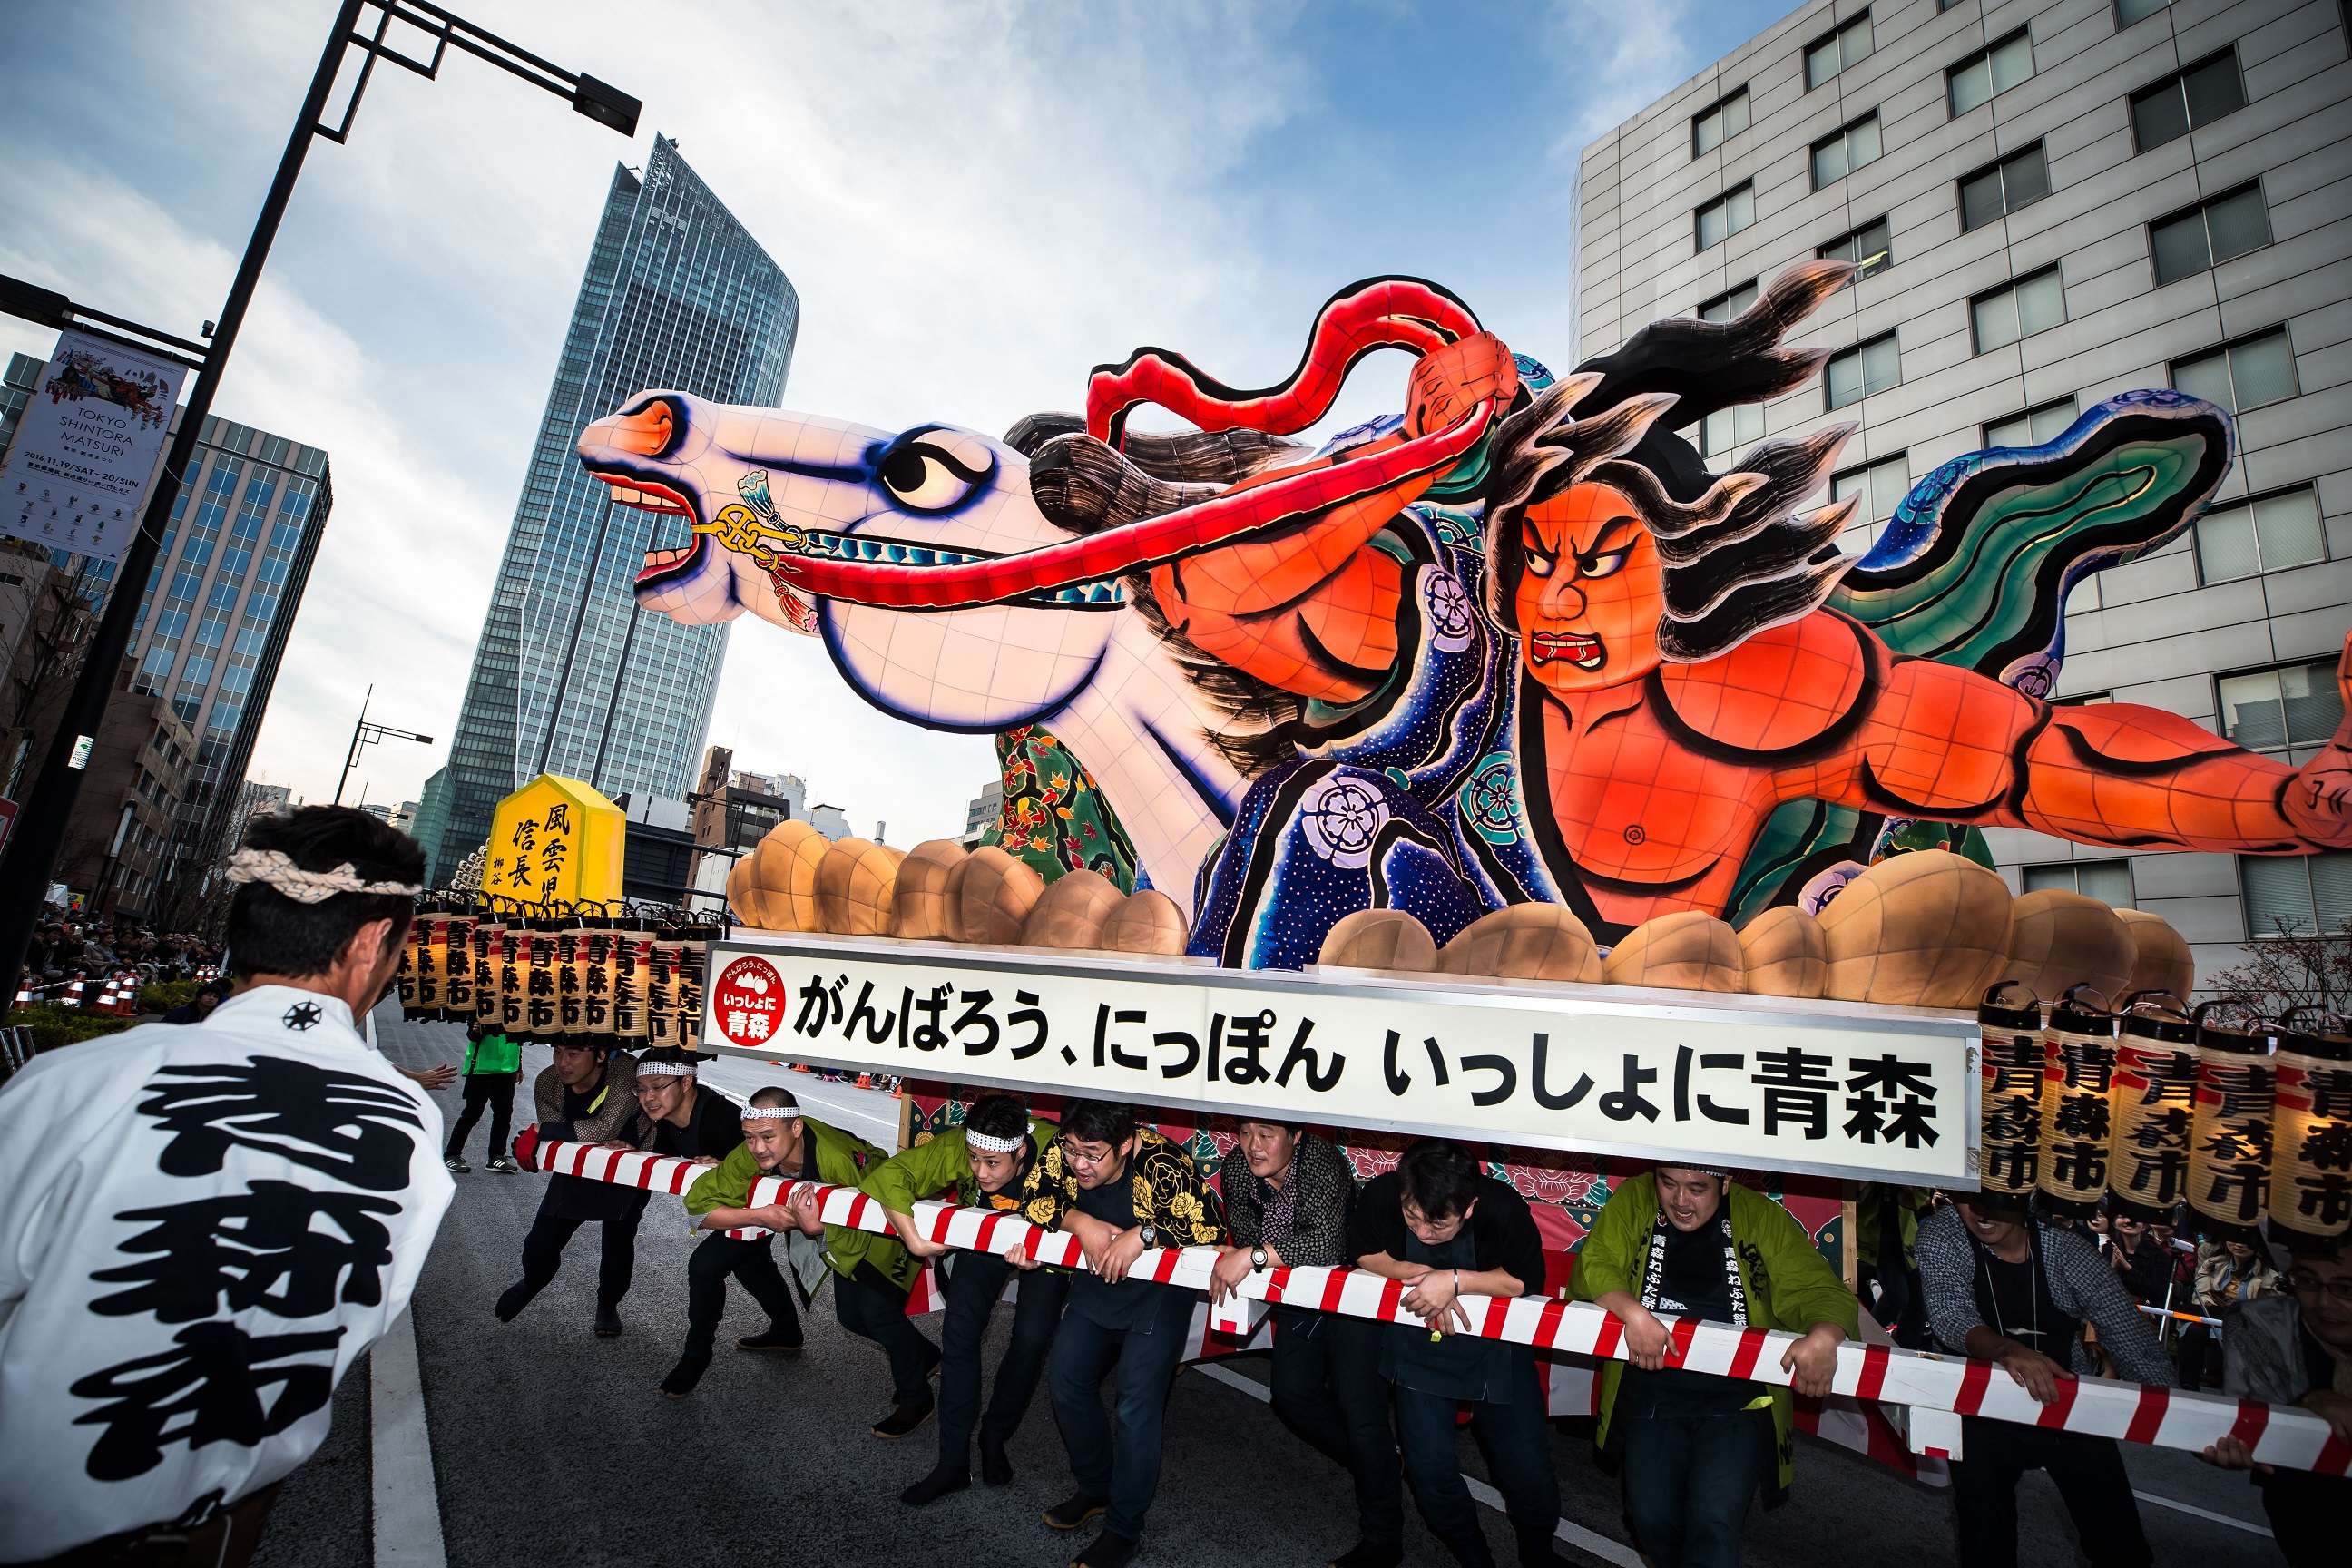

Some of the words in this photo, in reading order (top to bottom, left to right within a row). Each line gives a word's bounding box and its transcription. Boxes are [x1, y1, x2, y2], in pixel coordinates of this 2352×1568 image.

[59, 416, 133, 446] SHINTORA
[60, 431, 125, 457] MATSURI
[77, 407, 127, 429] TOKYO
[508, 819, 540, 888] 信長
[542, 803, 571, 907] 風雲児
[446, 920, 473, 1006] 青森市
[475, 928, 497, 1019] 青森市
[502, 934, 523, 1025] 青森市
[528, 937, 558, 1028] 青森市
[559, 934, 583, 1026] 青森市
[585, 934, 614, 1026] 青森市
[613, 935, 645, 1033] 青森市
[646, 945, 680, 1044] 青森市
[677, 946, 705, 1046] 青森市
[723, 993, 777, 1011] いっしょに
[727, 1009, 769, 1040] 青森
[793, 973, 1347, 1093] がんばろう、にっぽん
[1383, 1028, 1941, 1150] いっしょに青森
[1982, 1035, 2046, 1190] 青森市
[2051, 1043, 2118, 1191] 青森市
[2124, 1050, 2201, 1204] 青森市
[2197, 1063, 2277, 1221] 青森市
[1641, 1234, 1667, 1310] 青森ねぶた祭
[1723, 1246, 1748, 1326] 青森ねぶた祭
